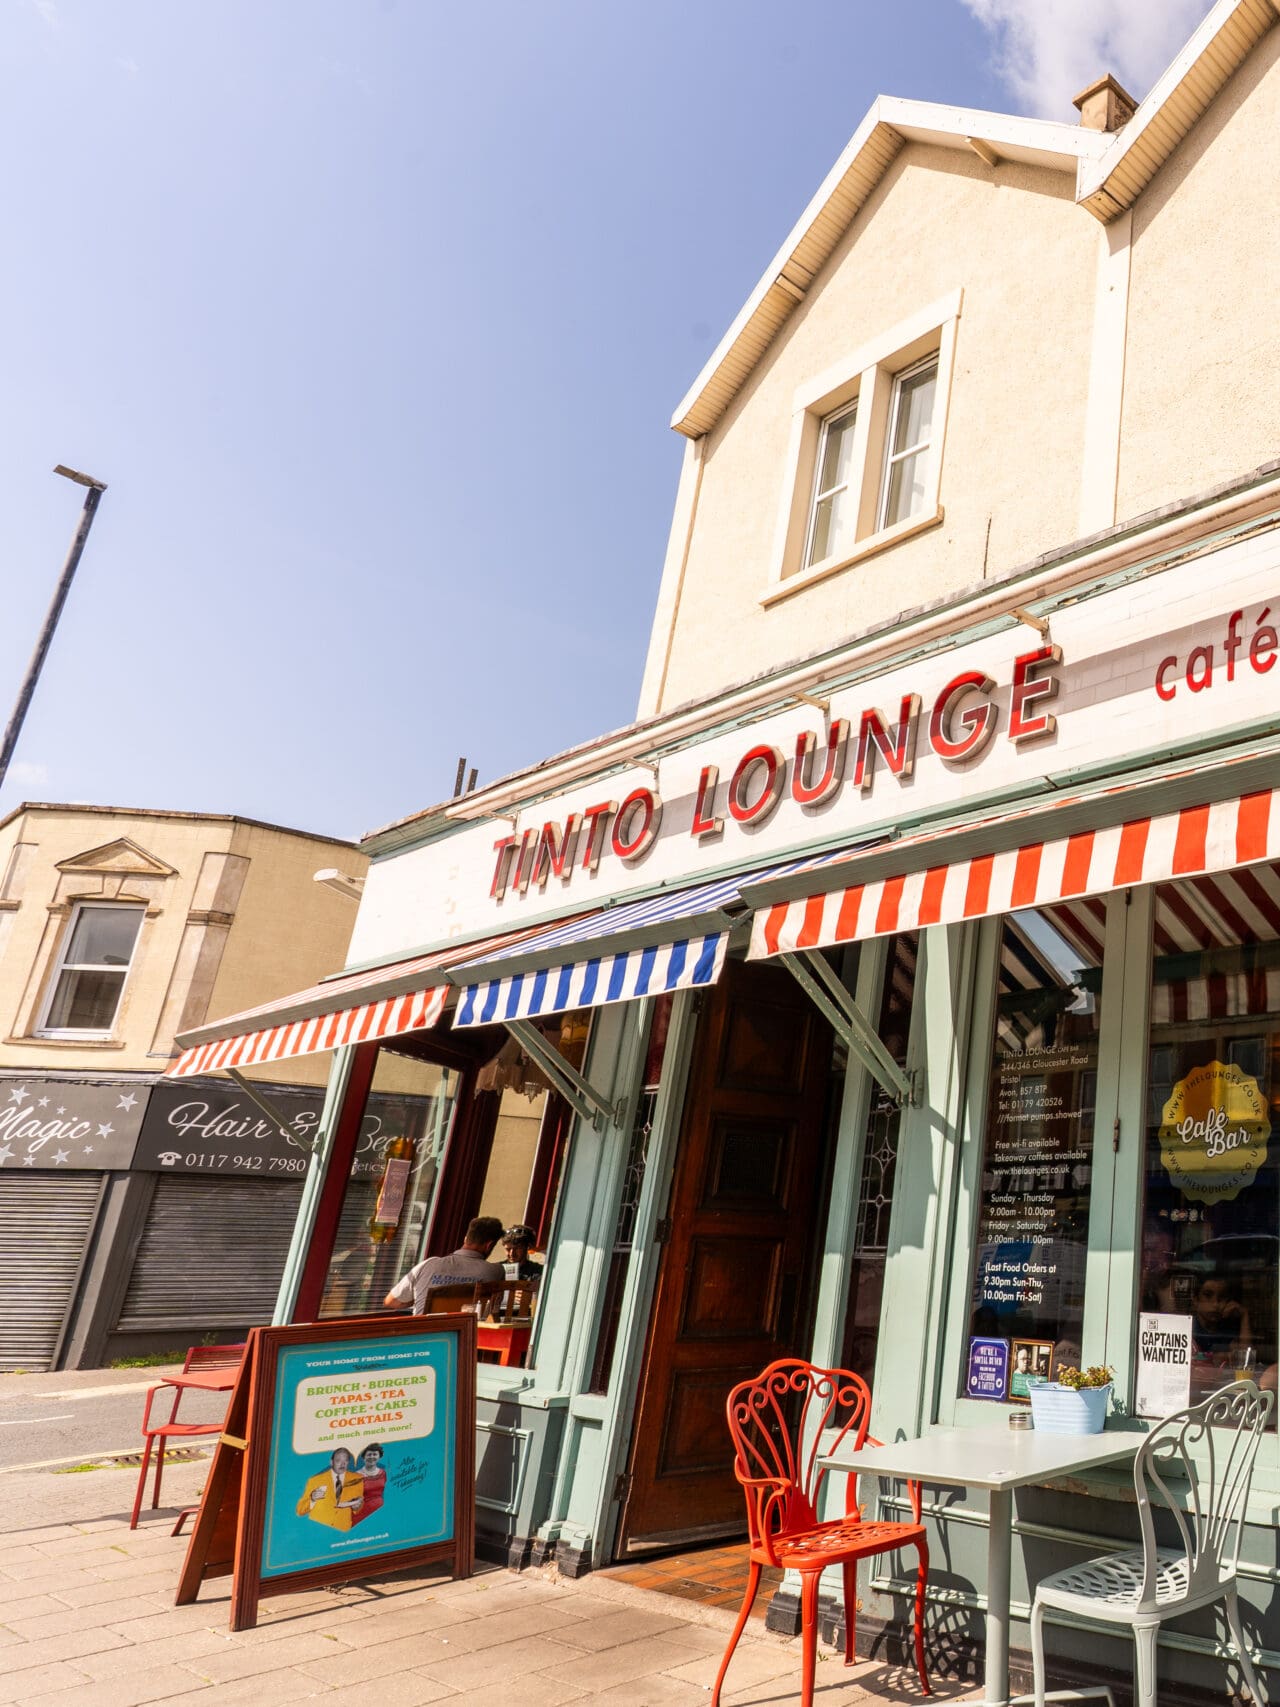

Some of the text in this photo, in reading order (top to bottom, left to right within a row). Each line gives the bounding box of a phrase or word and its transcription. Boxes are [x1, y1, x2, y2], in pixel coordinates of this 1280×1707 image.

[1155, 606, 1278, 701] café
[489, 643, 1063, 899] TINTO LOUNGE
[1003, 1049, 1023, 1058] TINTO
[1025, 1046, 1056, 1057] LOUNGE
[1001, 1055, 1088, 1072] 344/346 Gloucester Road
[1000, 1074, 1021, 1084] Bristol
[999, 1089, 1018, 1097] Avon,
[998, 1097, 1063, 1110] Tel: 01179 420526
[168, 1102, 273, 1138] Hair
[1176, 1104, 1230, 1143] Café
[995, 1137, 1060, 1149] Free wi-fi available
[1207, 1127, 1250, 1158] Bar
[185, 1153, 307, 1171] 0117 942 7980
[994, 1150, 1087, 1163] Takeaway coffees available
[993, 1165, 1070, 1176] www.thelounges.co.uk
[991, 1192, 1055, 1204] Sunday Thursday
[989, 1206, 1056, 1218] 9.00am 10.00pm
[988, 1220, 1048, 1232] Friday Saturday
[987, 1234, 1054, 1246] 9.00am 11.00pm
[985, 1261, 1057, 1273] (Last Food Orders at
[984, 1275, 1044, 1290] 9.30pm Sun-Thu,
[983, 1289, 1043, 1305] 10.00pm Fri-Sat)
[1142, 1331, 1188, 1348] CAPTAINS
[306, 1360, 331, 1368] YOUR
[333, 1358, 359, 1366] HOME
[361, 1355, 386, 1363] FROM
[388, 1352, 412, 1360] HOME
[1142, 1346, 1189, 1365] WANTED.
[306, 1375, 428, 1397] BRUNCH BURGERS
[329, 1389, 405, 1406] TAPAS TEA
[315, 1398, 418, 1419] COFFEE CAKES
[329, 1411, 404, 1429] COCKTAILS
[318, 1423, 413, 1442] and much much more!
